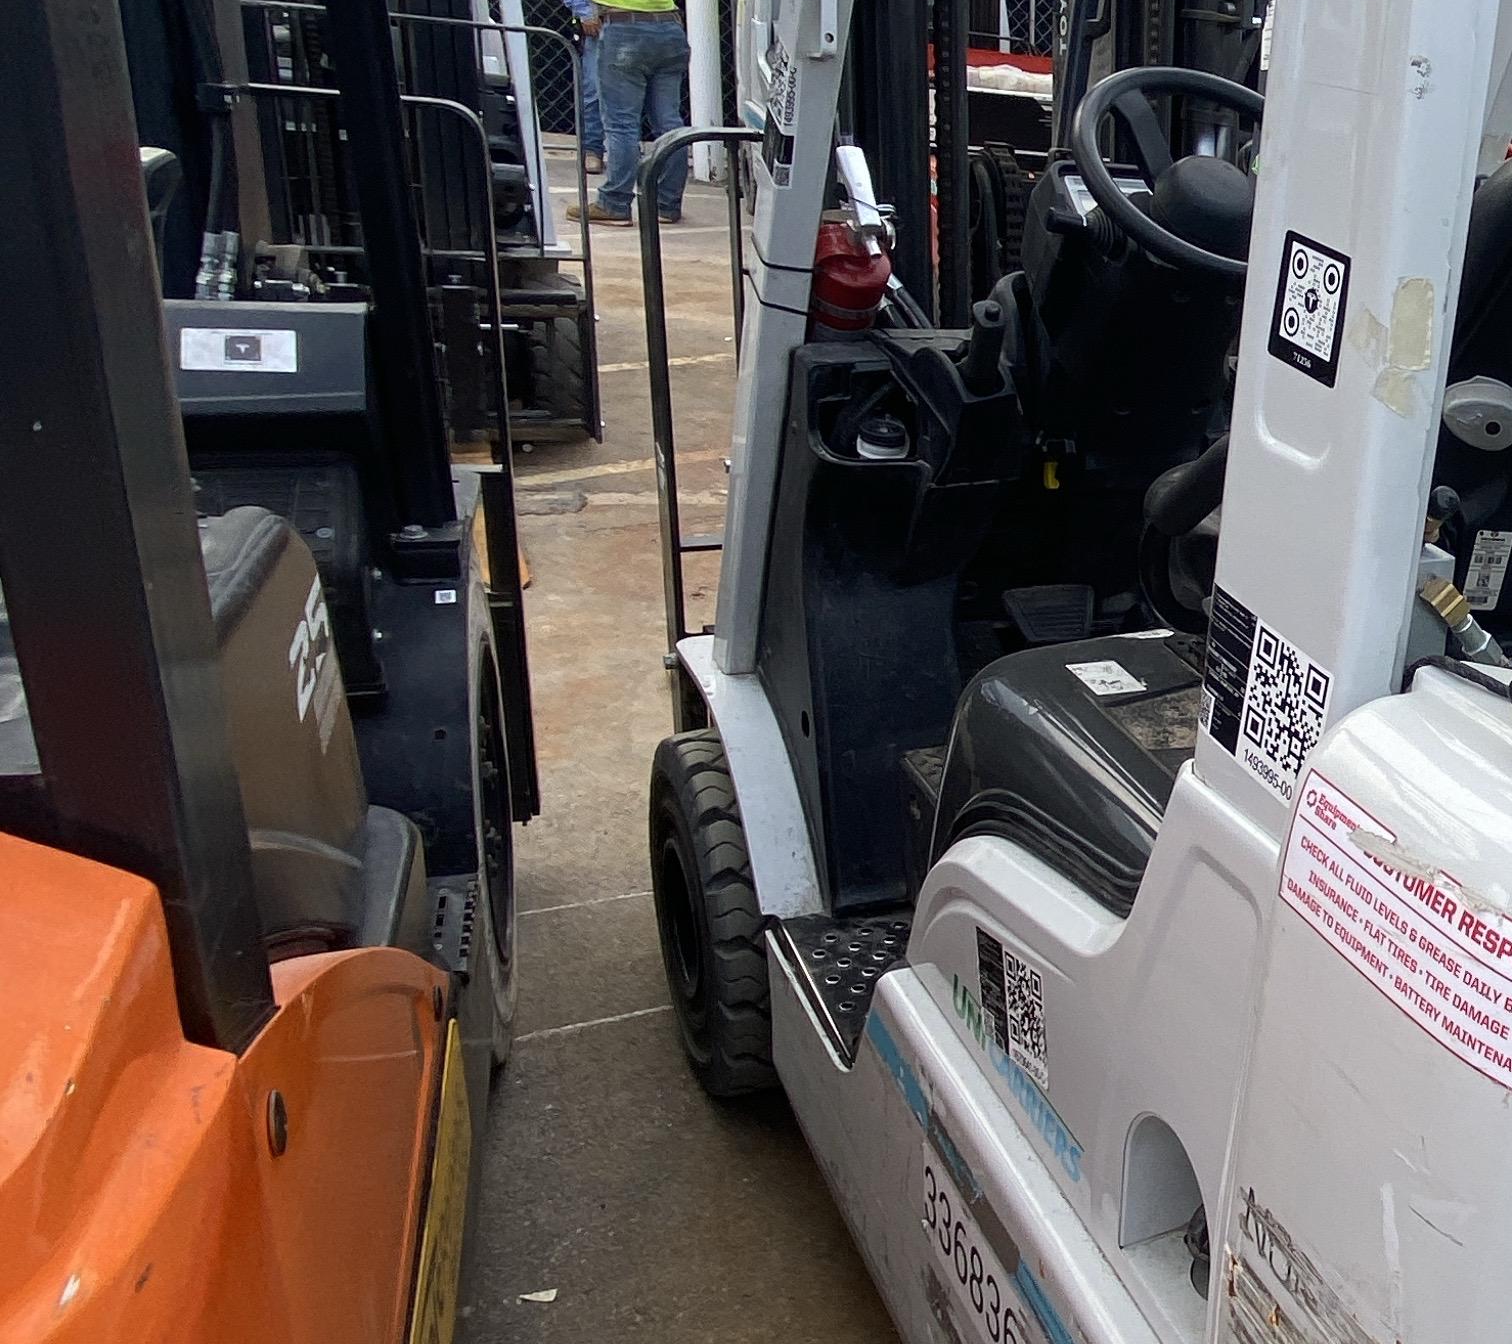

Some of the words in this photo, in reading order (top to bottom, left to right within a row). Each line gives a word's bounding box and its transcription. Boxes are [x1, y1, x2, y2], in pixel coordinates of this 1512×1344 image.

[1286, 876, 1322, 919] DAMAGE
[1322, 911, 1335, 929] TO
[1333, 920, 1390, 979] EQUIPMENT
[1394, 974, 1441, 1023] BATTERY
[1300, 835, 1329, 868] CHECK
[1328, 860, 1344, 883] ALL
[1345, 873, 1374, 906] FLUID
[1373, 897, 1409, 936] LEVELS
[1418, 935, 1462, 979] GREASE
[1462, 969, 1503, 1005] DAILY
[1307, 869, 1360, 924] INSURANCE
[1363, 919, 1386, 947] FLAT
[1386, 939, 1418, 975] TIRES
[1425, 969, 1452, 1002] TIRE
[1451, 992, 1511, 1041] DAMAGE
